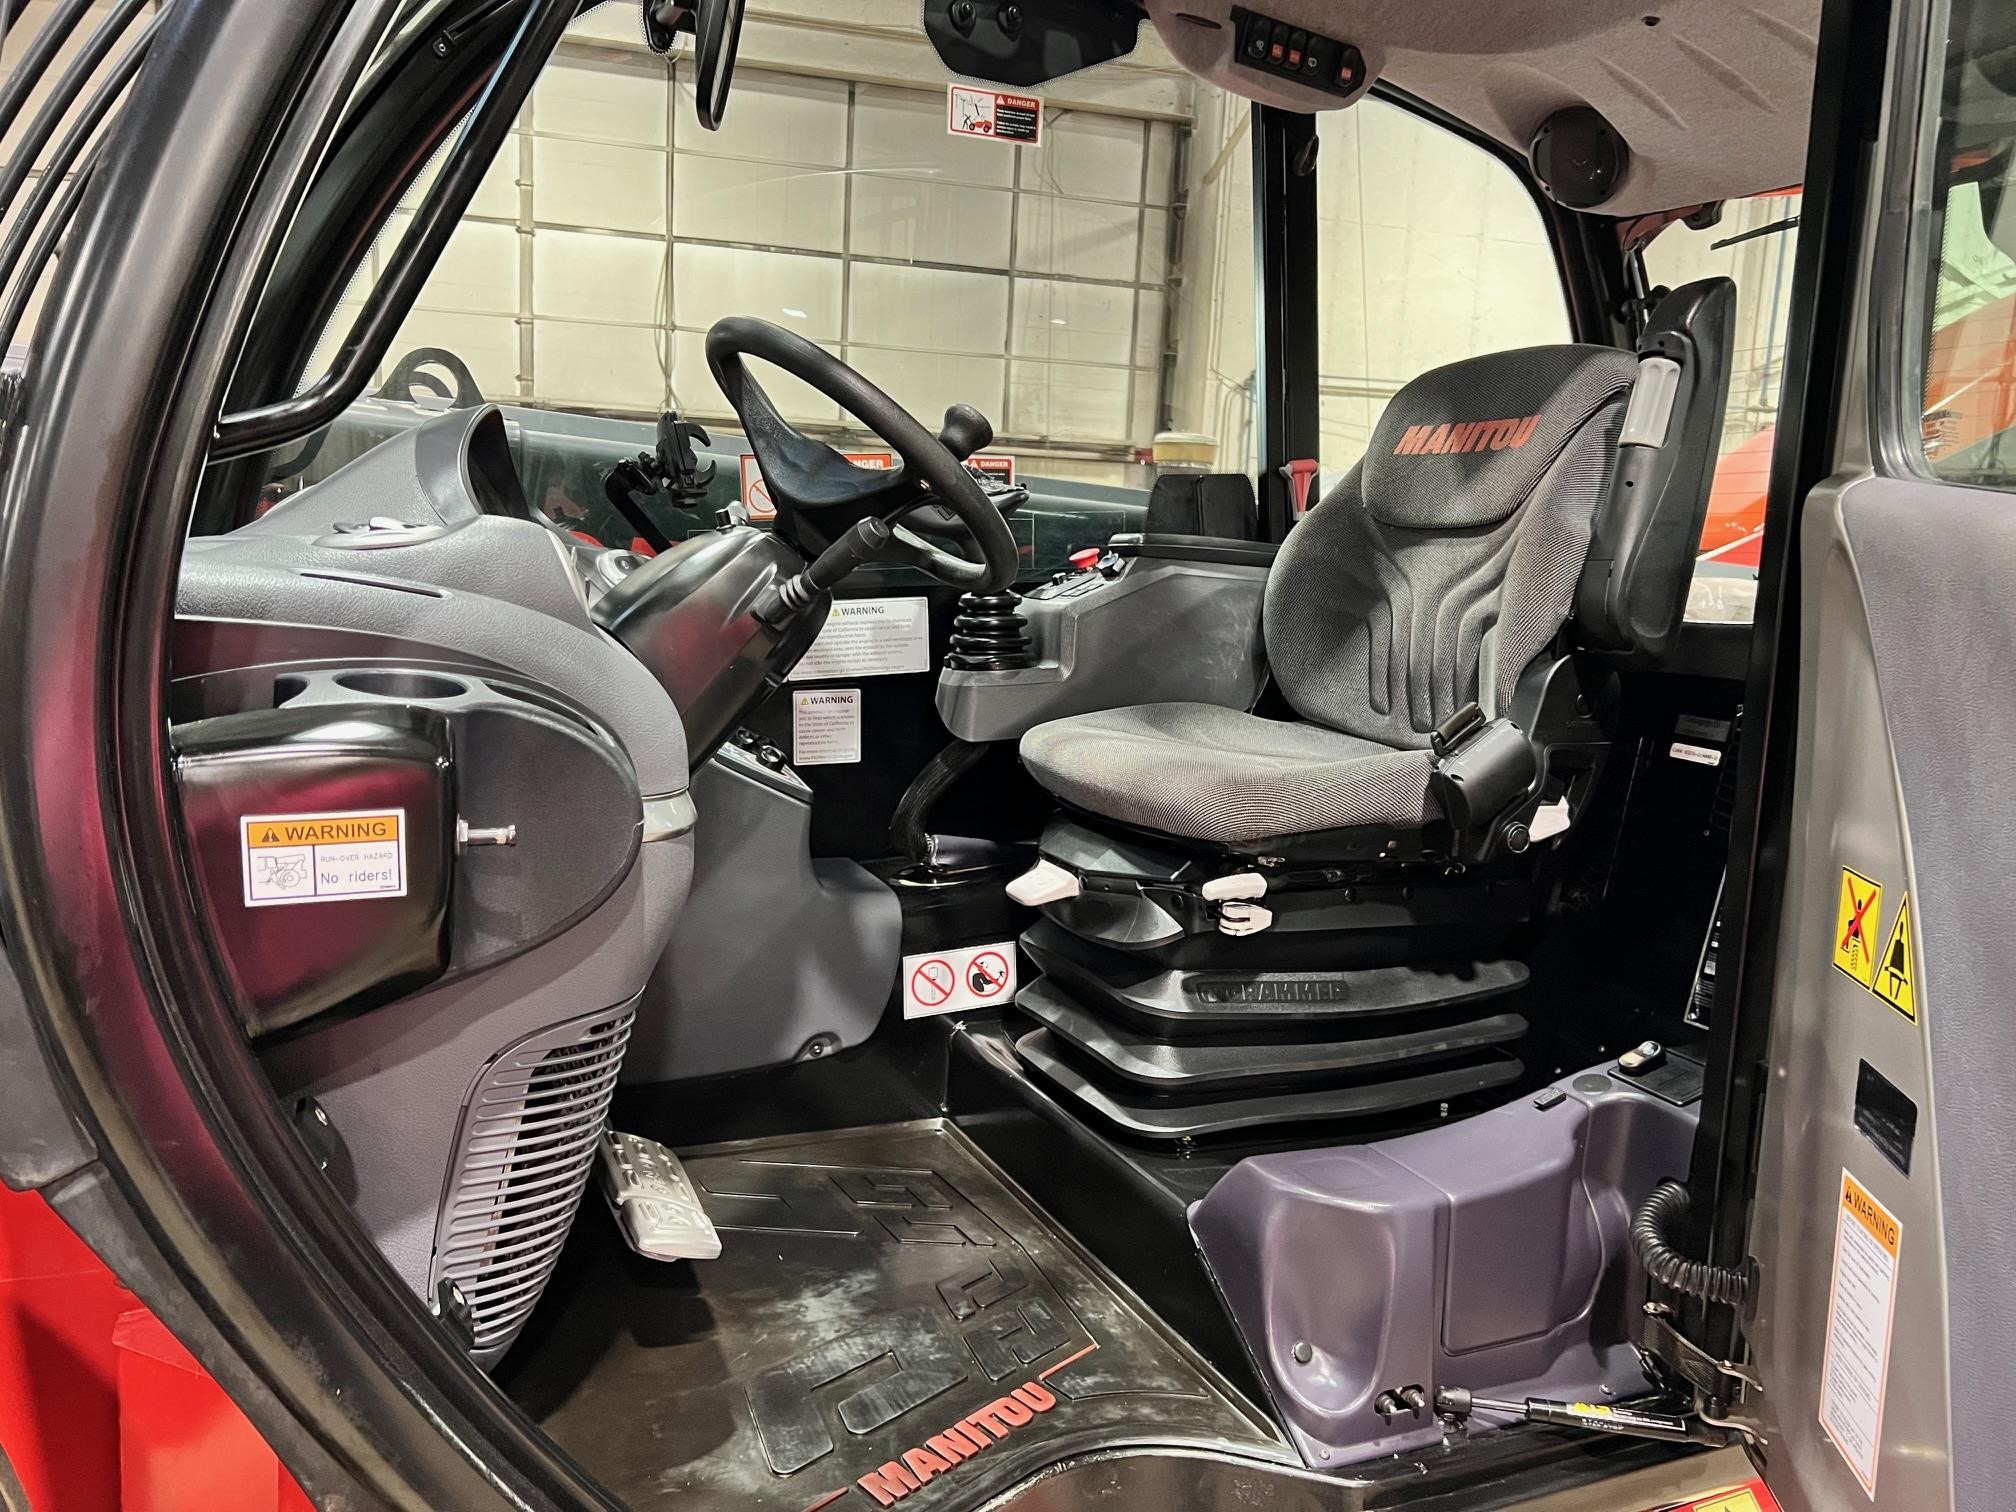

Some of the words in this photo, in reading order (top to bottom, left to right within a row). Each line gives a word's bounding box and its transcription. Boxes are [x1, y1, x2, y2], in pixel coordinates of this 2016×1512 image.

[1007, 98, 1036, 108] DANGER
[1393, 415, 1542, 455] MANITOU
[853, 459, 884, 469] NGER
[841, 606, 885, 616] WARNING
[810, 695, 854, 705] WARNING
[285, 822, 387, 841] WARNING
[320, 854, 360, 863] RUN-OVER
[364, 852, 393, 860] HAZARD
[321, 873, 339, 884] No
[349, 868, 392, 882] riders!
[1854, 1192, 1895, 1246] WARNING
[857, 1381, 1057, 1509] MANITOU
